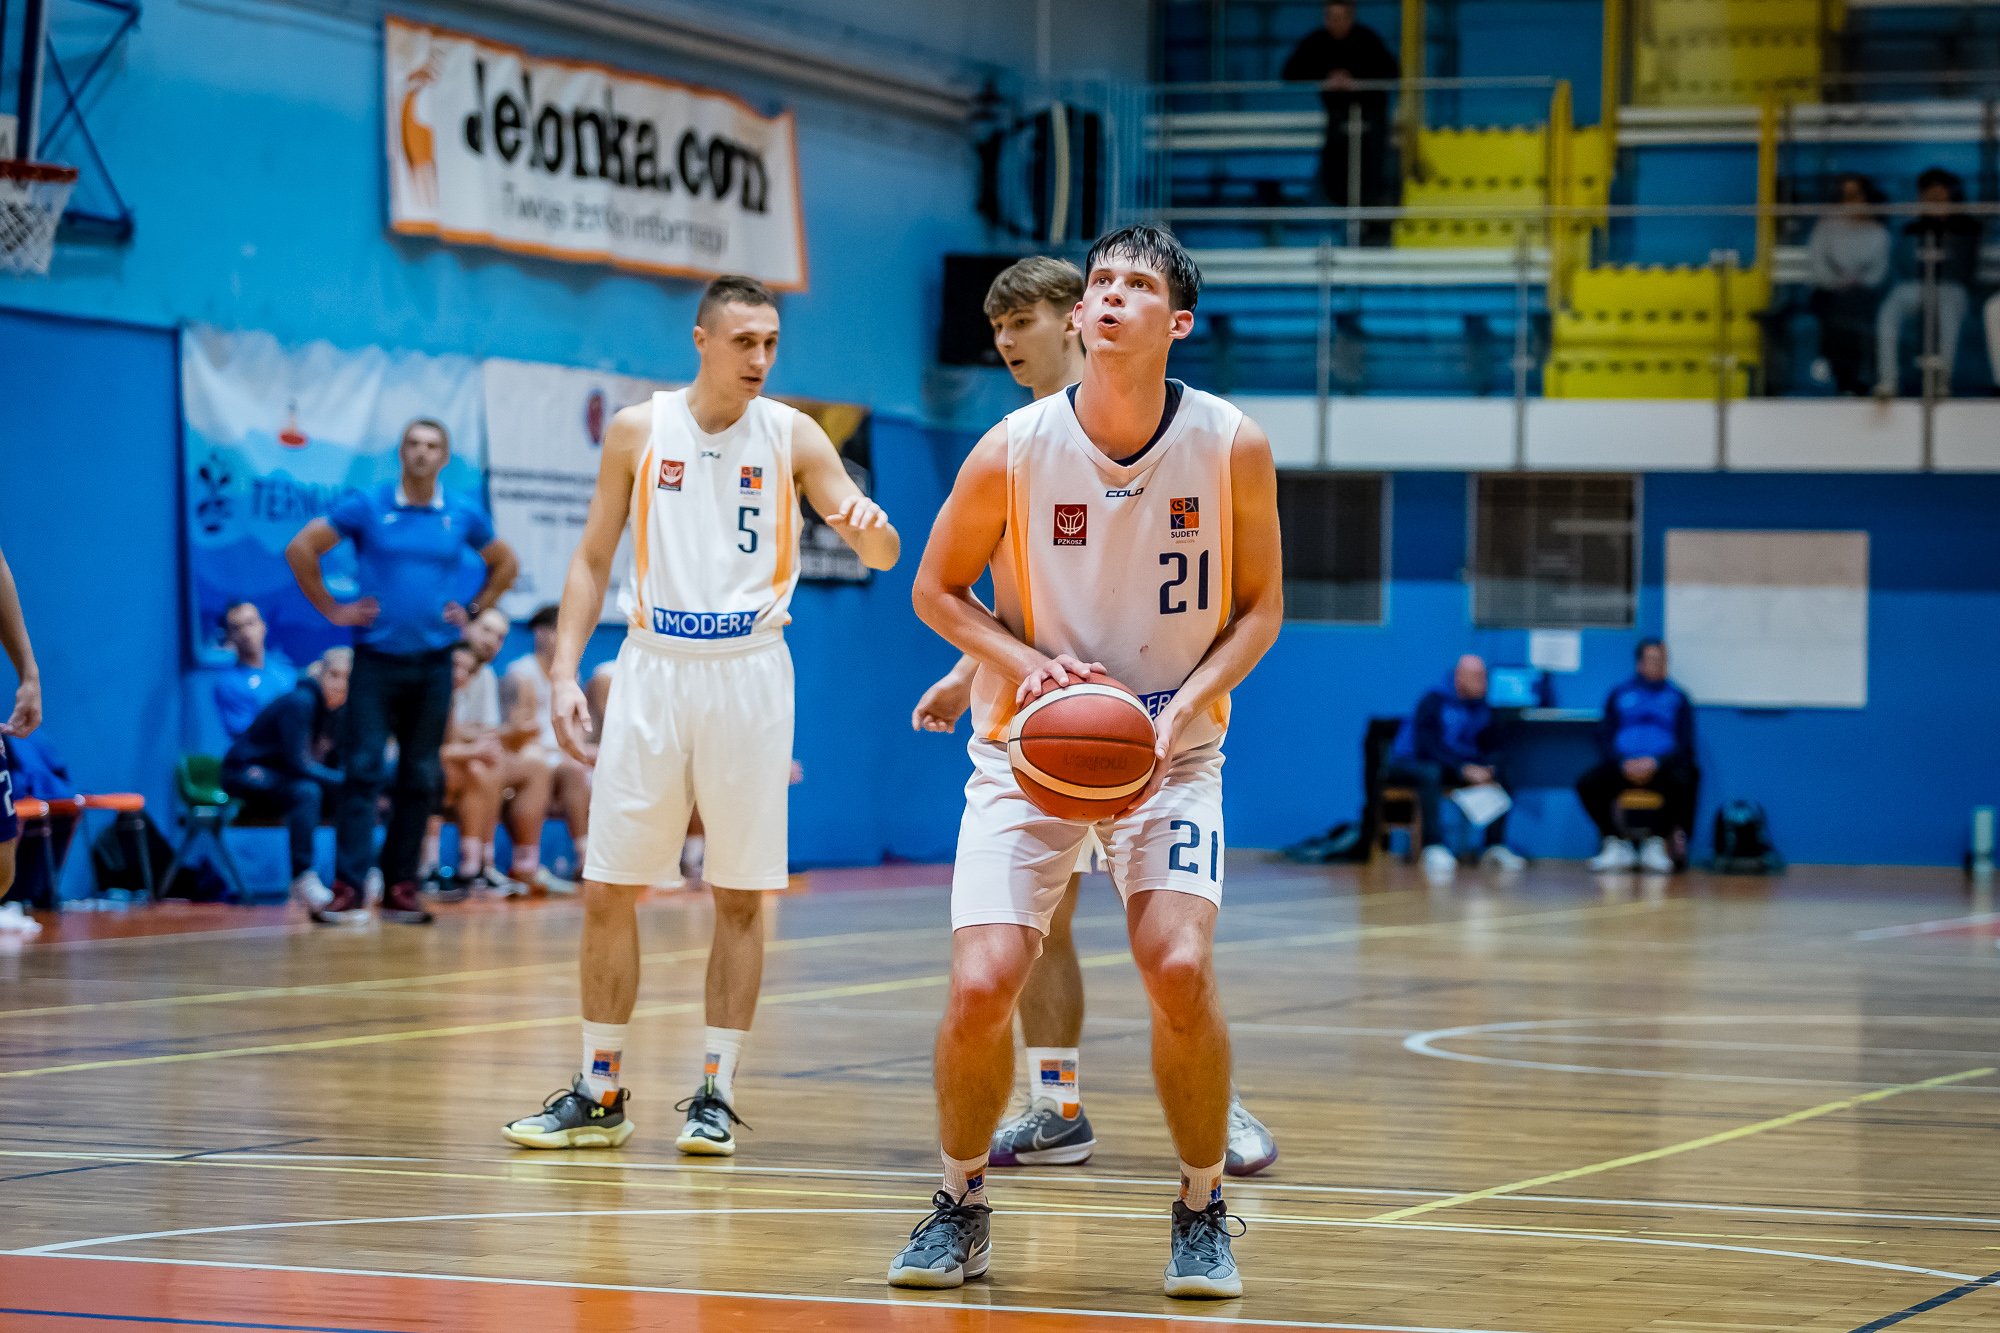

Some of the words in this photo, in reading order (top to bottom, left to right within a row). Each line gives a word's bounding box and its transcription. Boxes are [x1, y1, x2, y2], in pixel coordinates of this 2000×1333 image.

[1105, 488, 1145, 497] COLO
[738, 506, 760, 554] 5
[1170, 530, 1200, 538] SUDETY
[1159, 550, 1209, 615] 21
[1169, 819, 1219, 883] 21
